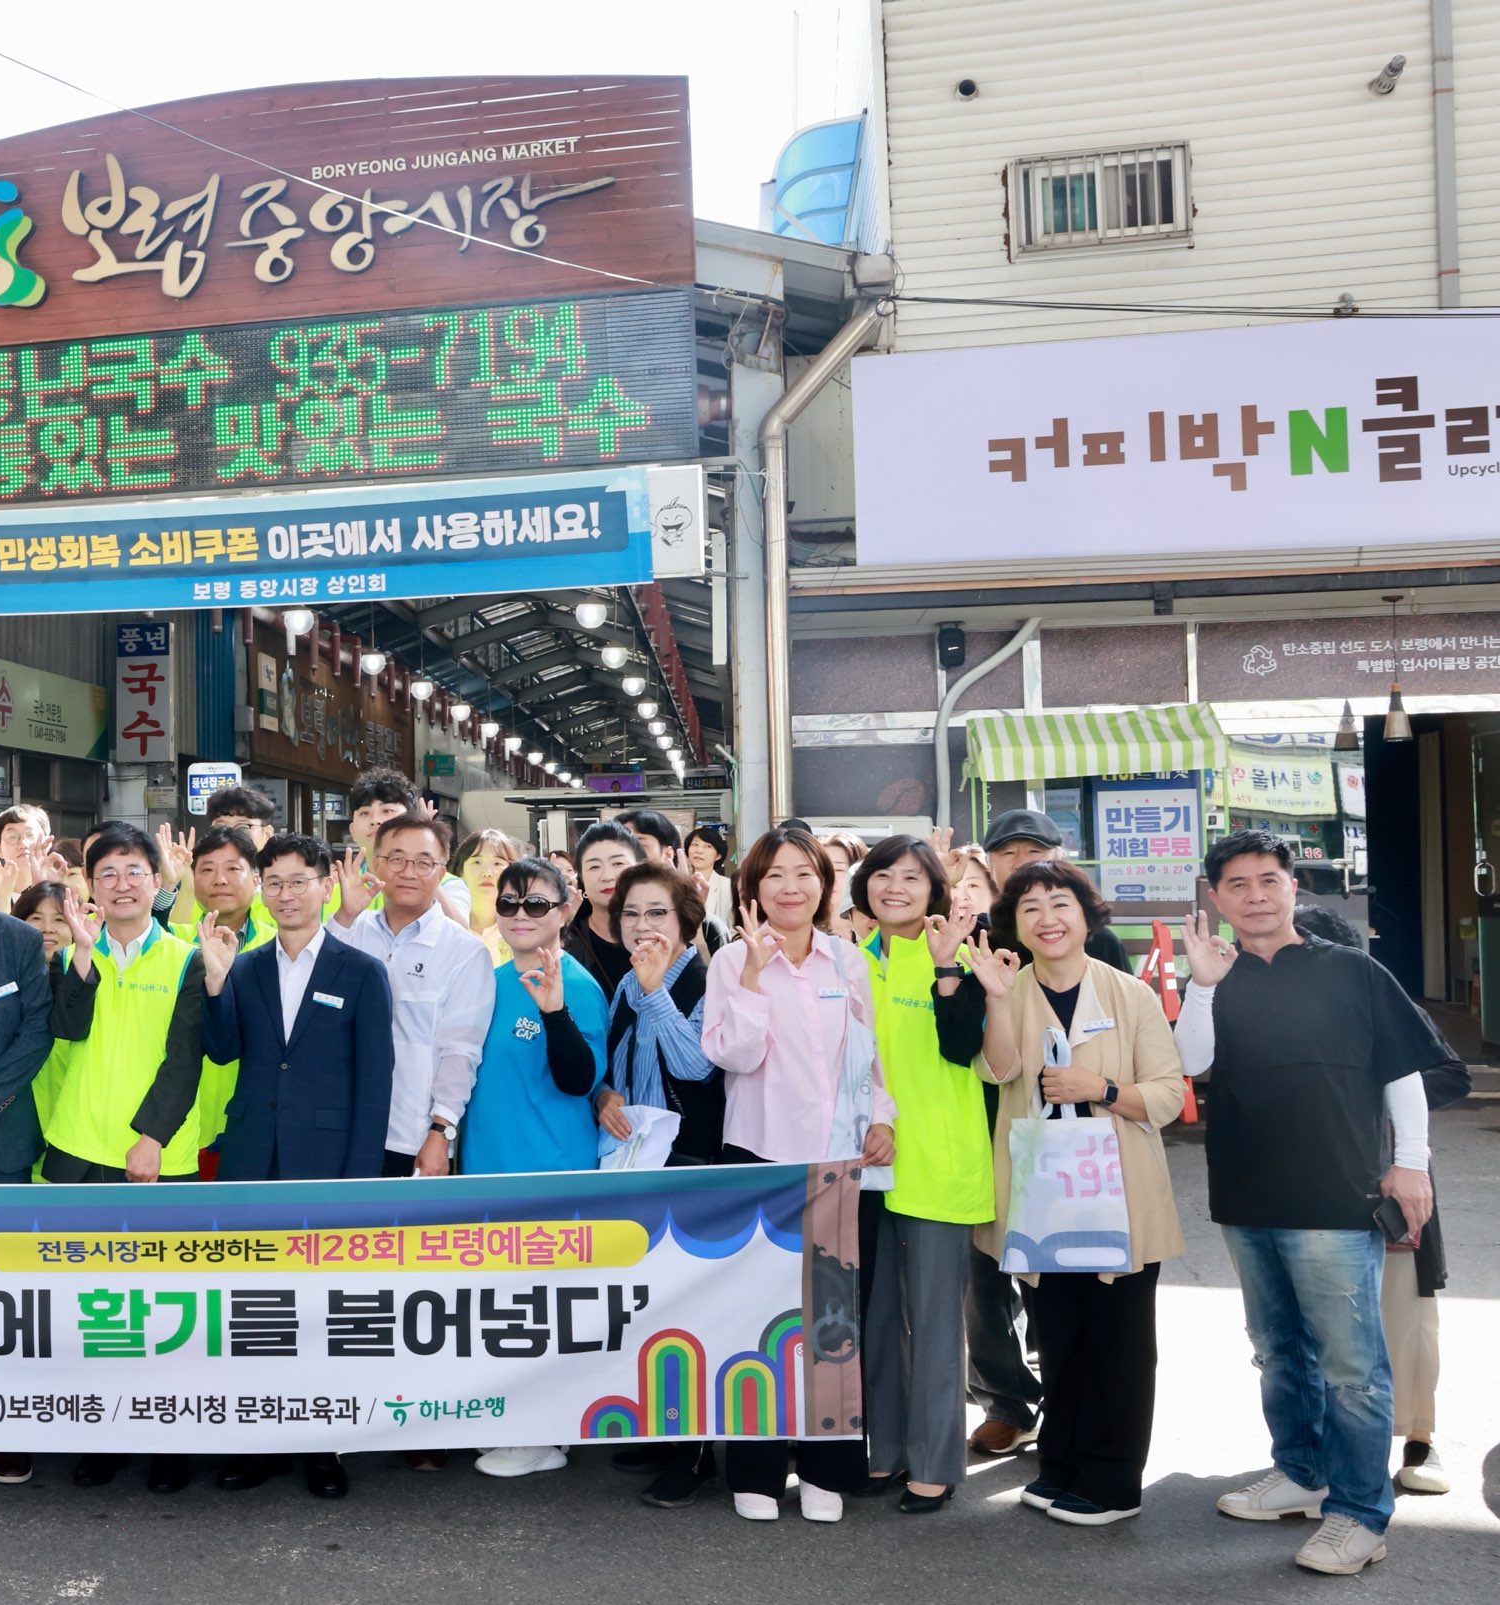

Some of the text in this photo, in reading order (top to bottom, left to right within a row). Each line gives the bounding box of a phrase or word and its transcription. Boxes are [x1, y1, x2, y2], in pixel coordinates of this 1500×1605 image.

[311, 138, 579, 181] BORYEONG JUNGANG MARKET
[61, 153, 617, 298] 보령 중앙시장
[269, 305, 588, 398] 935-7194
[213, 394, 446, 480] 맛있는
[488, 375, 651, 462] 국수
[1448, 461, 1500, 478] Upcycl
[129, 525, 260, 566] 소비쿠폰
[267, 514, 403, 561] 이곳에서
[410, 500, 602, 552] 사용하세요!
[193, 574, 387, 601] 보령 중앙시장 상인회
[118, 626, 167, 653] 풍년
[1282, 635, 1500, 656] 탄소중립 선도 도시 보령에서 만나는
[1356, 655, 1500, 673] 특별한 업사이클링 공간
[33, 700, 62, 723] 국수 전문점
[121, 662, 166, 757] 국수
[1105, 805, 1192, 834] 만들기
[1107, 837, 1193, 858] 체험무료
[515, 1017, 541, 1034] BREAD
[515, 1028, 535, 1040] CAT
[37, 1225, 594, 1266] 전통시장과 상생하는 제28회 보령예술제
[76, 1286, 300, 1359] 활기를
[129, 1394, 228, 1424] 보령시청
[235, 1394, 361, 1425] 문화교육과
[419, 1395, 506, 1420] 하나은행
